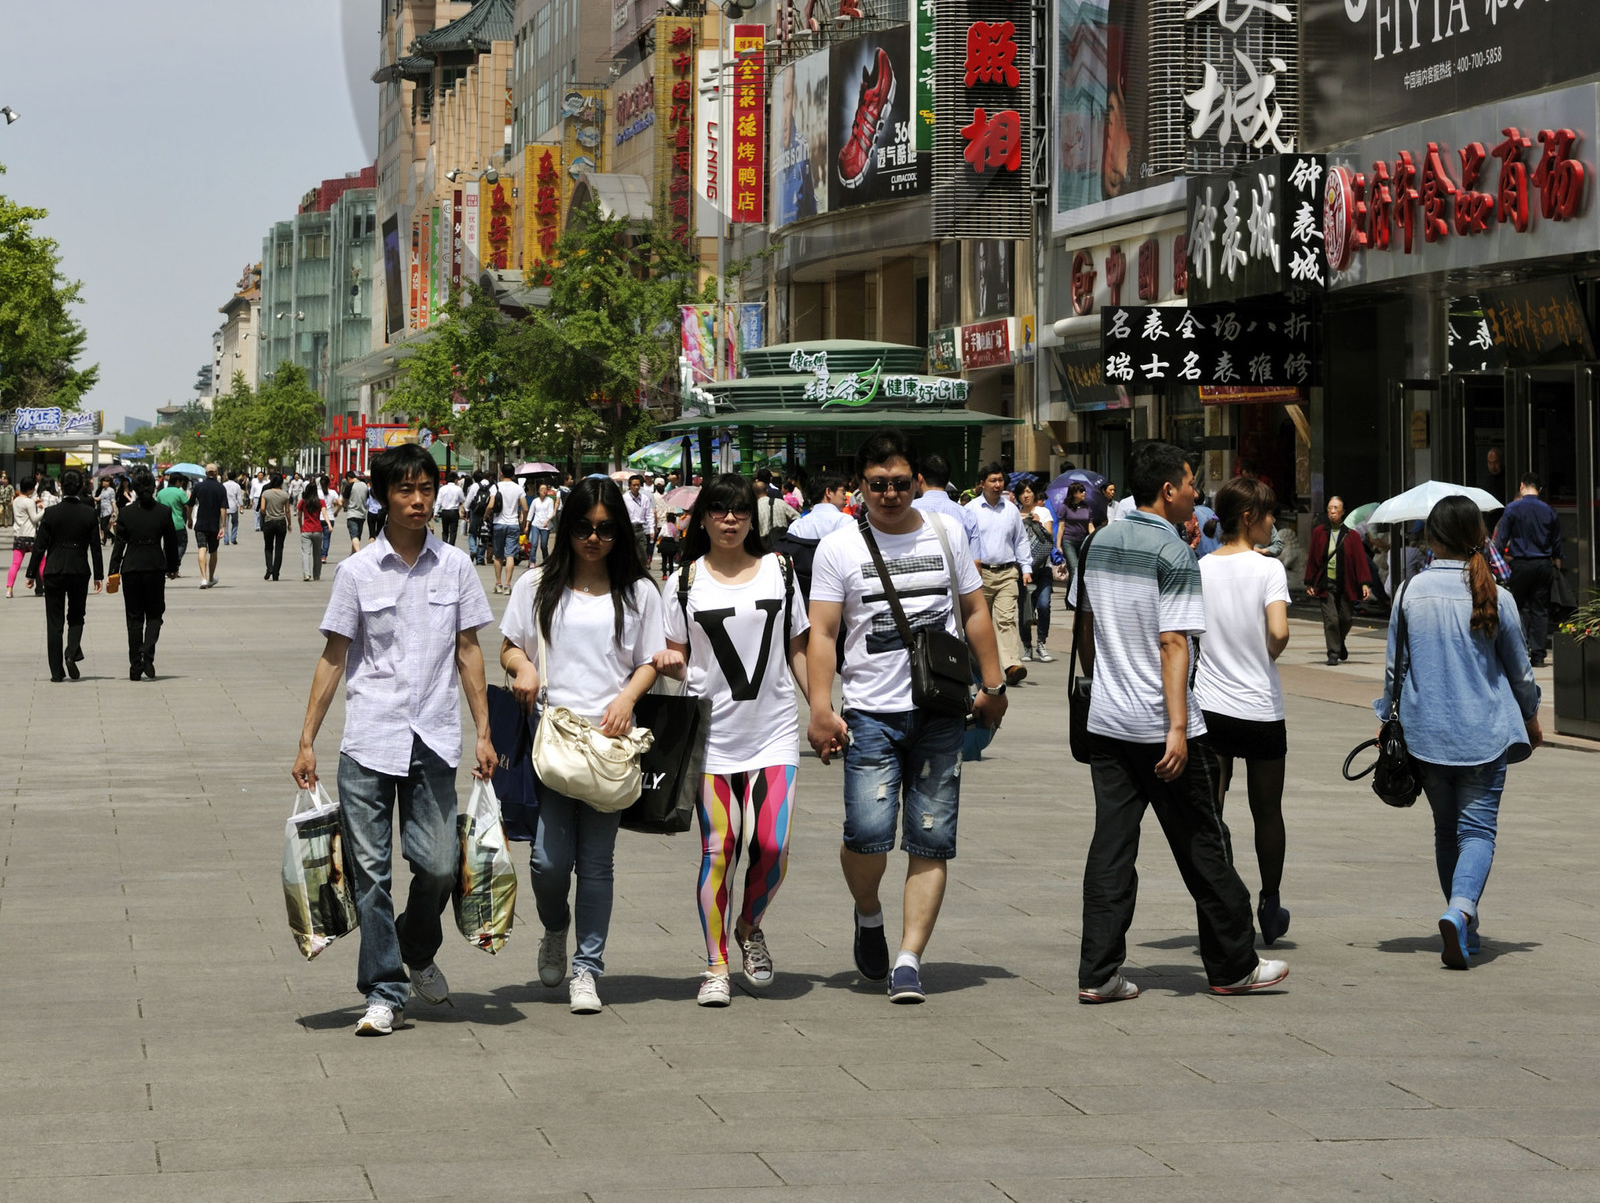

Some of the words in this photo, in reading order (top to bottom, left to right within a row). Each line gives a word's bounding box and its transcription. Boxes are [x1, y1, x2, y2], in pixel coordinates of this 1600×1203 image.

[706, 121, 718, 200] LI-NING
[737, 58, 760, 211] 全聚德烤鸭店
[1187, 173, 1280, 289] 钟表城
[1288, 157, 1325, 287] 钟表城
[1106, 308, 1311, 342] 名表全场八折
[885, 376, 969, 404] 健康好心情
[1106, 351, 1312, 384] 瑞士名表维修
[692, 599, 784, 702] V
[641, 772, 666, 790] LY.
